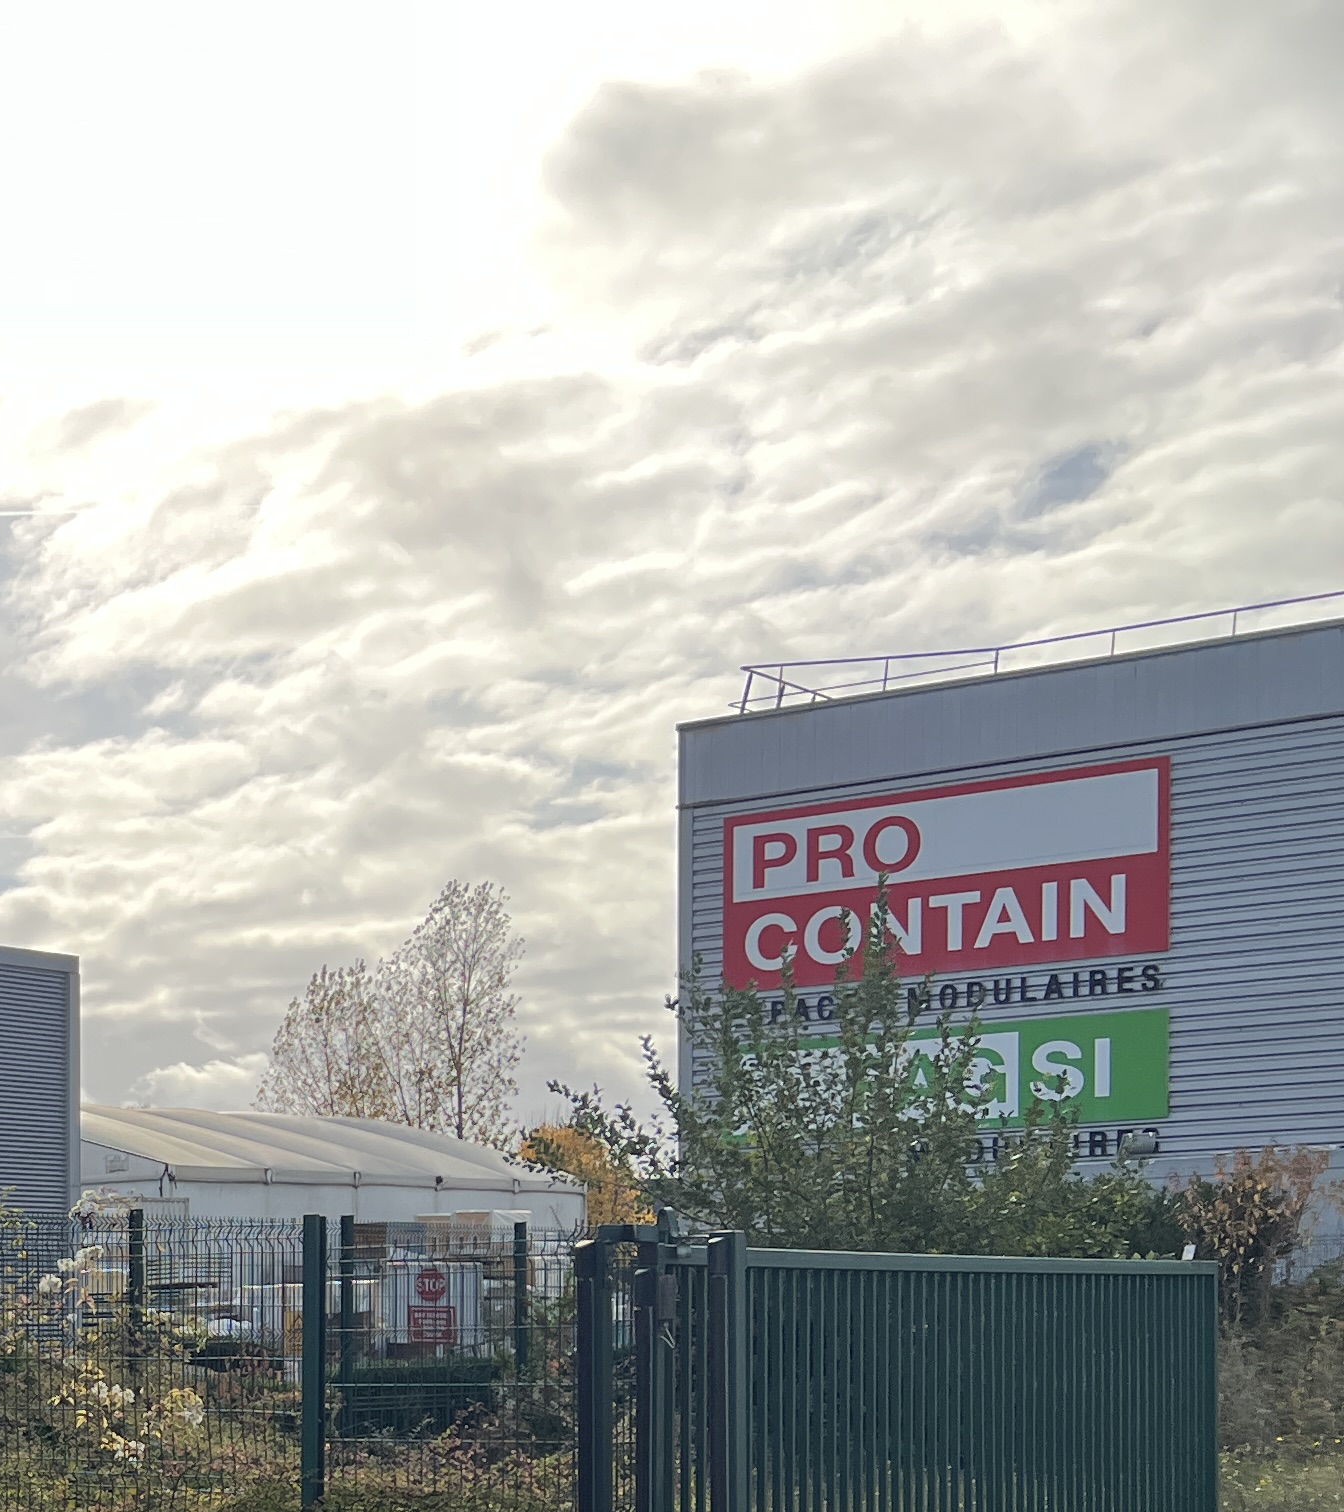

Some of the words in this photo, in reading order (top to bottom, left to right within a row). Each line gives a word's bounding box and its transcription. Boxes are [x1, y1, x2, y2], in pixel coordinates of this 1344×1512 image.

[752, 815, 921, 889] PRO
[744, 873, 1126, 971] CONTAIN
[416, 1278, 446, 1292] STOP
